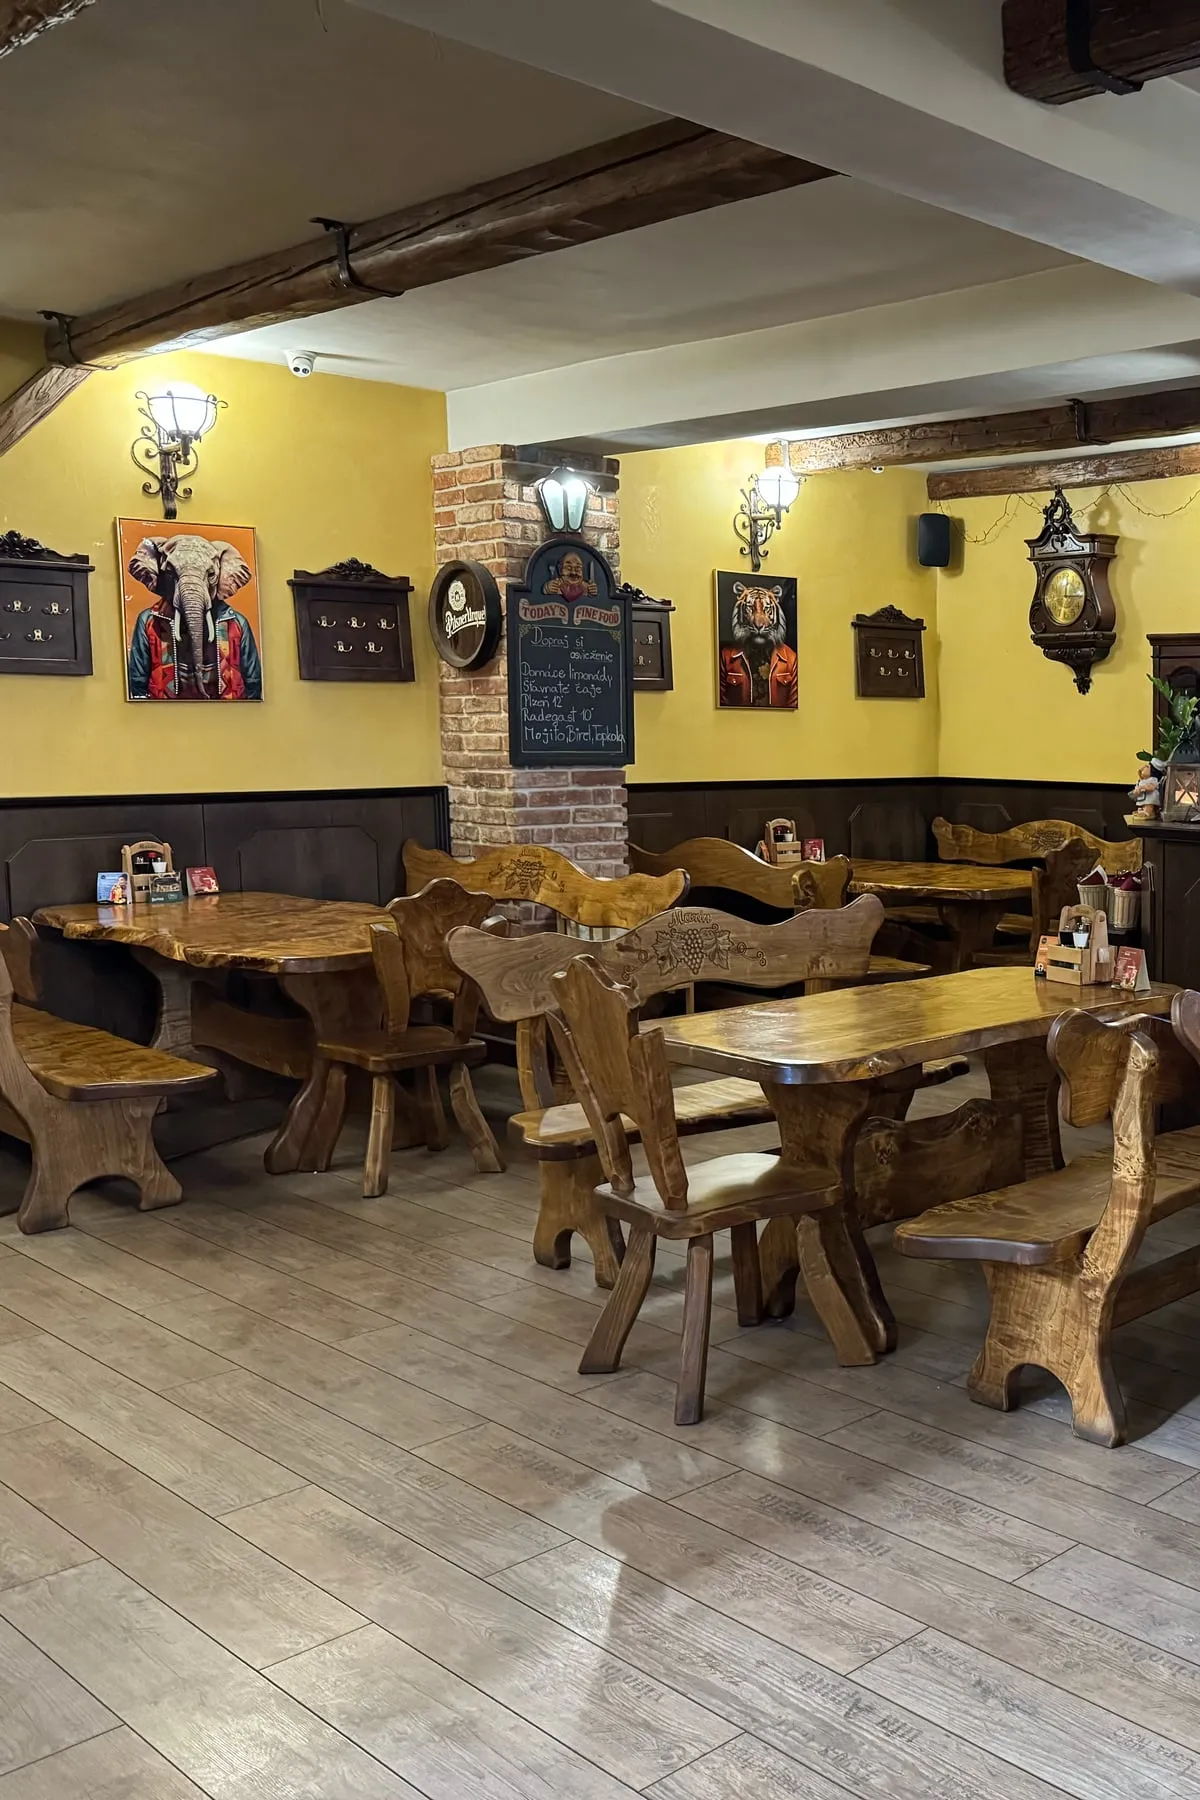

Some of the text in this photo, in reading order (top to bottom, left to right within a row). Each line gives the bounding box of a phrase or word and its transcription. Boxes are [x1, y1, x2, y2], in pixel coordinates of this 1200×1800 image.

[521, 605, 567, 619] TODAY'S
[575, 607, 620, 624] FINE FOOD
[530, 626, 584, 649] Dopraj si
[520, 661, 613, 689] Domáce limonády
[575, 682, 602, 698] čaje
[520, 705, 577, 726] Radegast
